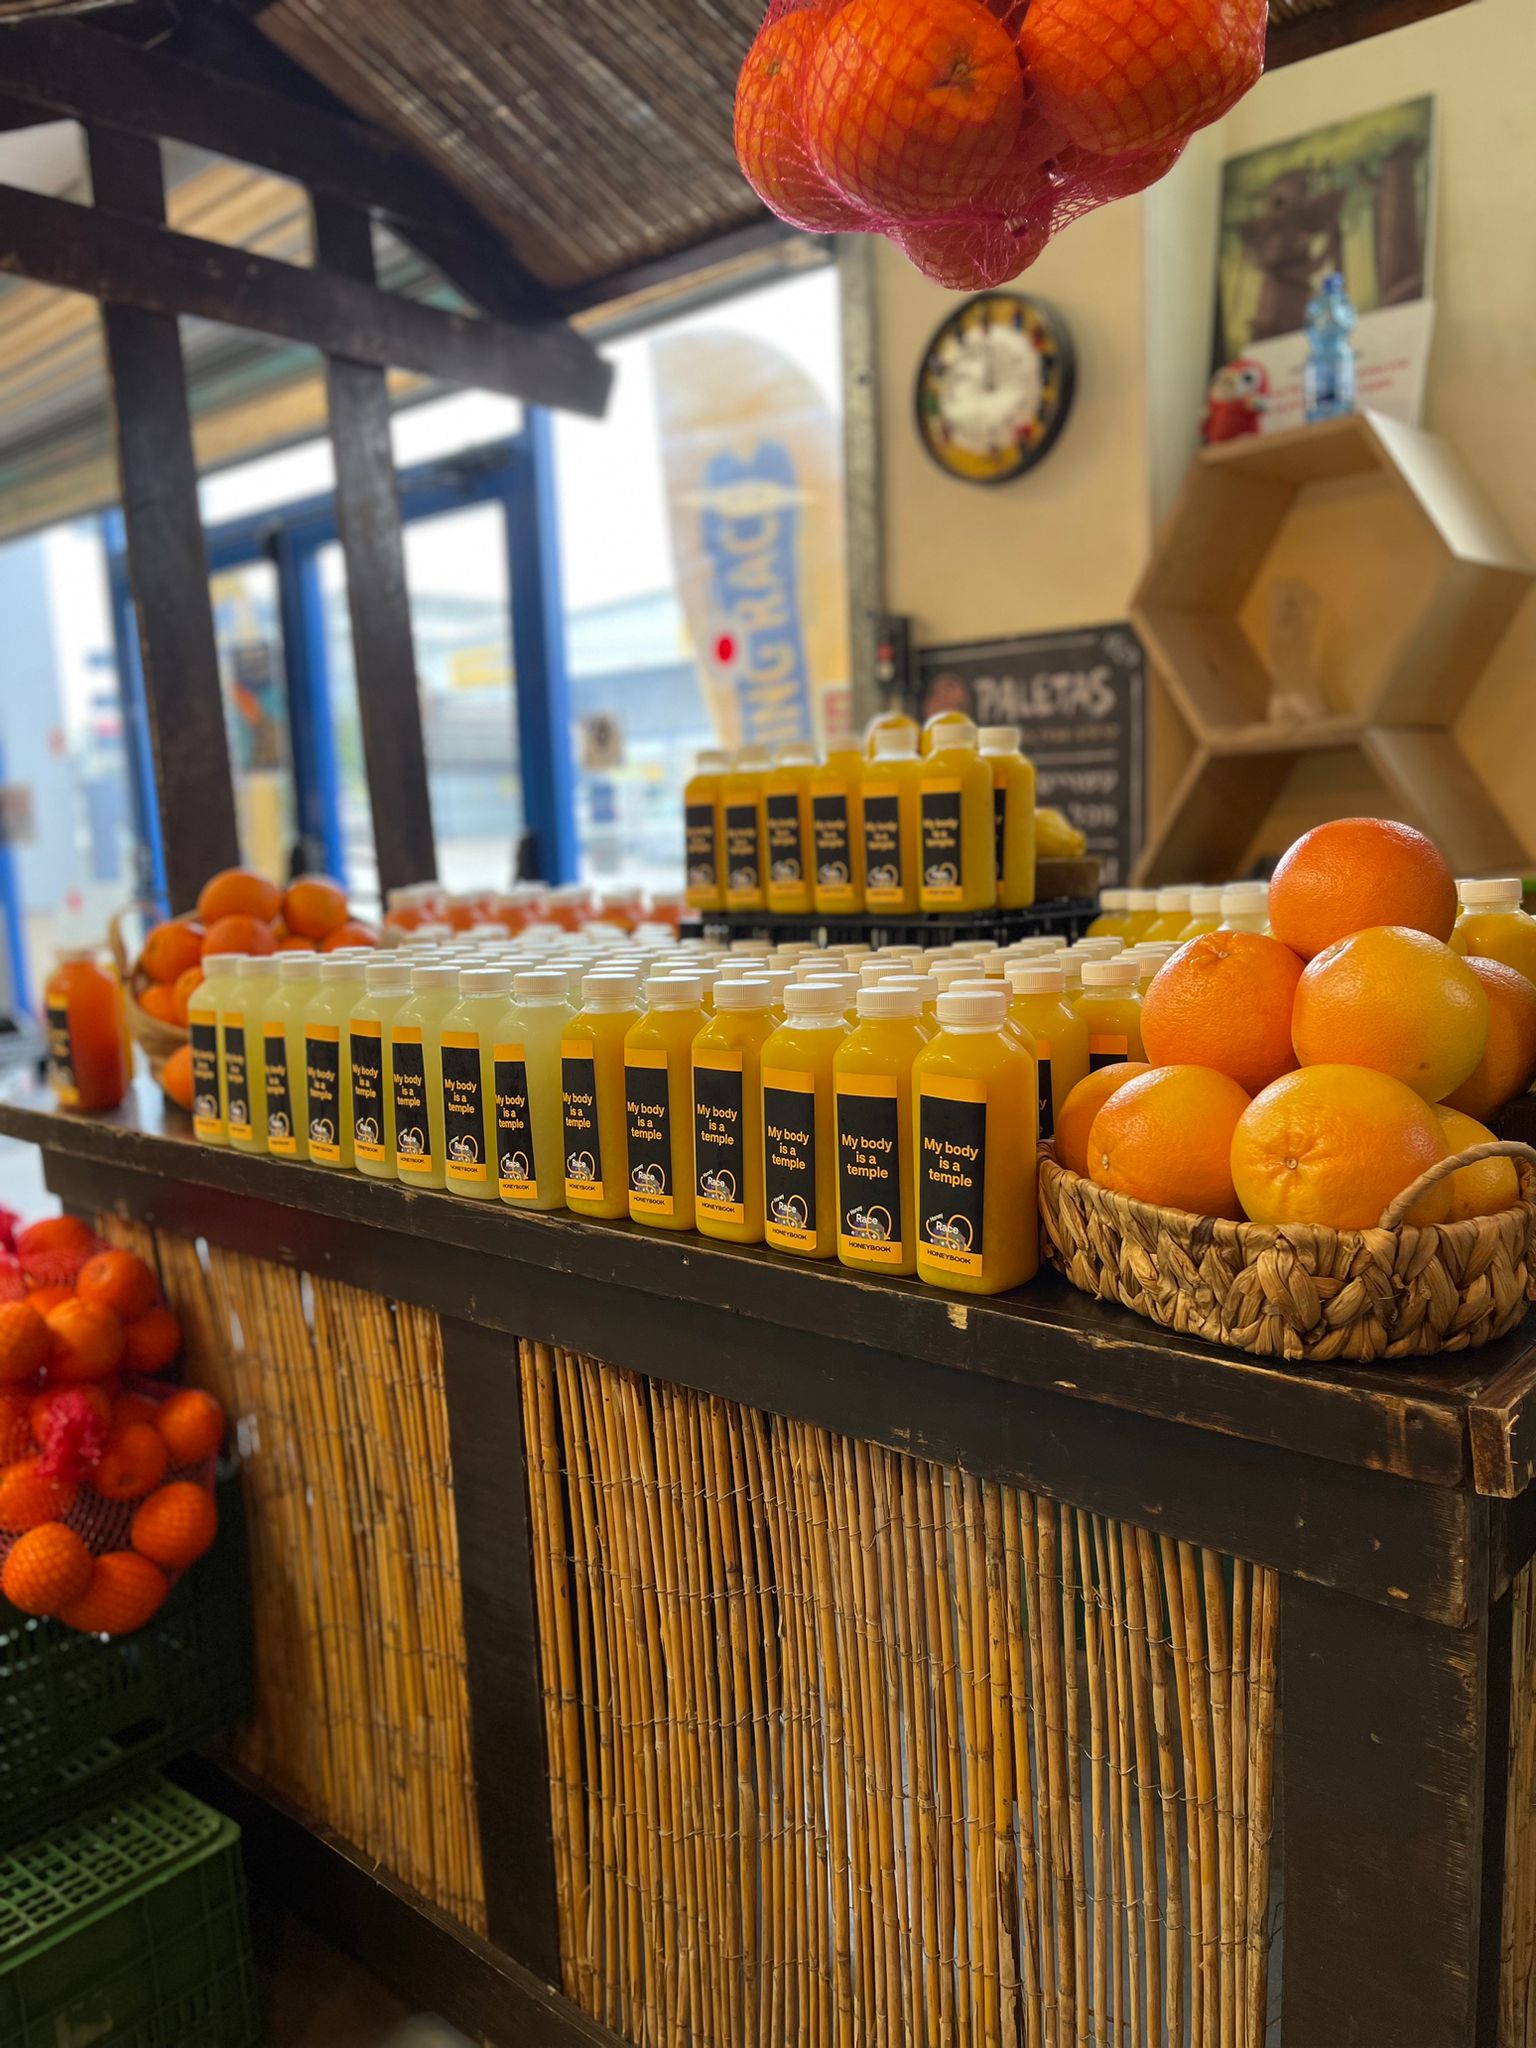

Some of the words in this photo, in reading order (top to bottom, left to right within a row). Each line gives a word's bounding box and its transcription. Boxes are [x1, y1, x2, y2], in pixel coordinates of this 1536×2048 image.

[974, 666, 1118, 723] PALETAS
[361, 1066, 378, 1079] body
[393, 1073, 403, 1085] My
[404, 1074, 422, 1087] body
[444, 1078, 455, 1092] My
[456, 1080, 477, 1093] body
[355, 1086, 376, 1099] temple
[401, 1086, 408, 1096] is
[453, 1091, 461, 1102] is
[461, 1094, 467, 1103] a
[397, 1096, 421, 1108] temple
[505, 1095, 525, 1108] body
[572, 1093, 593, 1106] body
[448, 1103, 475, 1115] temple
[503, 1107, 510, 1118] is
[510, 1110, 516, 1118] a
[569, 1106, 577, 1116] is
[577, 1108, 583, 1117] a
[627, 1101, 639, 1115] My
[641, 1103, 665, 1117] body
[697, 1103, 711, 1119] My
[712, 1106, 738, 1122] body
[498, 1119, 524, 1131] temple
[565, 1117, 591, 1130] temple
[637, 1116, 645, 1127] is
[646, 1119, 653, 1128] a
[708, 1119, 717, 1131] is
[718, 1123, 725, 1132] a
[631, 1127, 662, 1141] temple
[701, 1130, 734, 1146] temple
[767, 1125, 783, 1141] My
[784, 1128, 810, 1146] body
[779, 1142, 788, 1155] is
[789, 1146, 796, 1156] a
[841, 1133, 858, 1150] My
[860, 1135, 893, 1153] body
[924, 1137, 943, 1155] My
[945, 1141, 979, 1161] body
[771, 1153, 806, 1170] temple
[856, 1151, 866, 1164] is
[868, 1154, 877, 1165] a
[939, 1156, 950, 1170] is
[952, 1161, 961, 1172] a
[638, 1171, 655, 1181] Race
[847, 1163, 889, 1180] temple
[928, 1168, 973, 1188] temple
[633, 1196, 665, 1205] HONEYBOOK
[701, 1202, 736, 1213] HONEYBOOK
[778, 1201, 797, 1214] Race
[855, 1213, 878, 1225] Race
[772, 1228, 807, 1240] HONEYBOOK
[935, 1221, 959, 1235] Race
[848, 1241, 891, 1253] HONEYBOOK
[927, 1249, 971, 1265] HONEYBOOK
